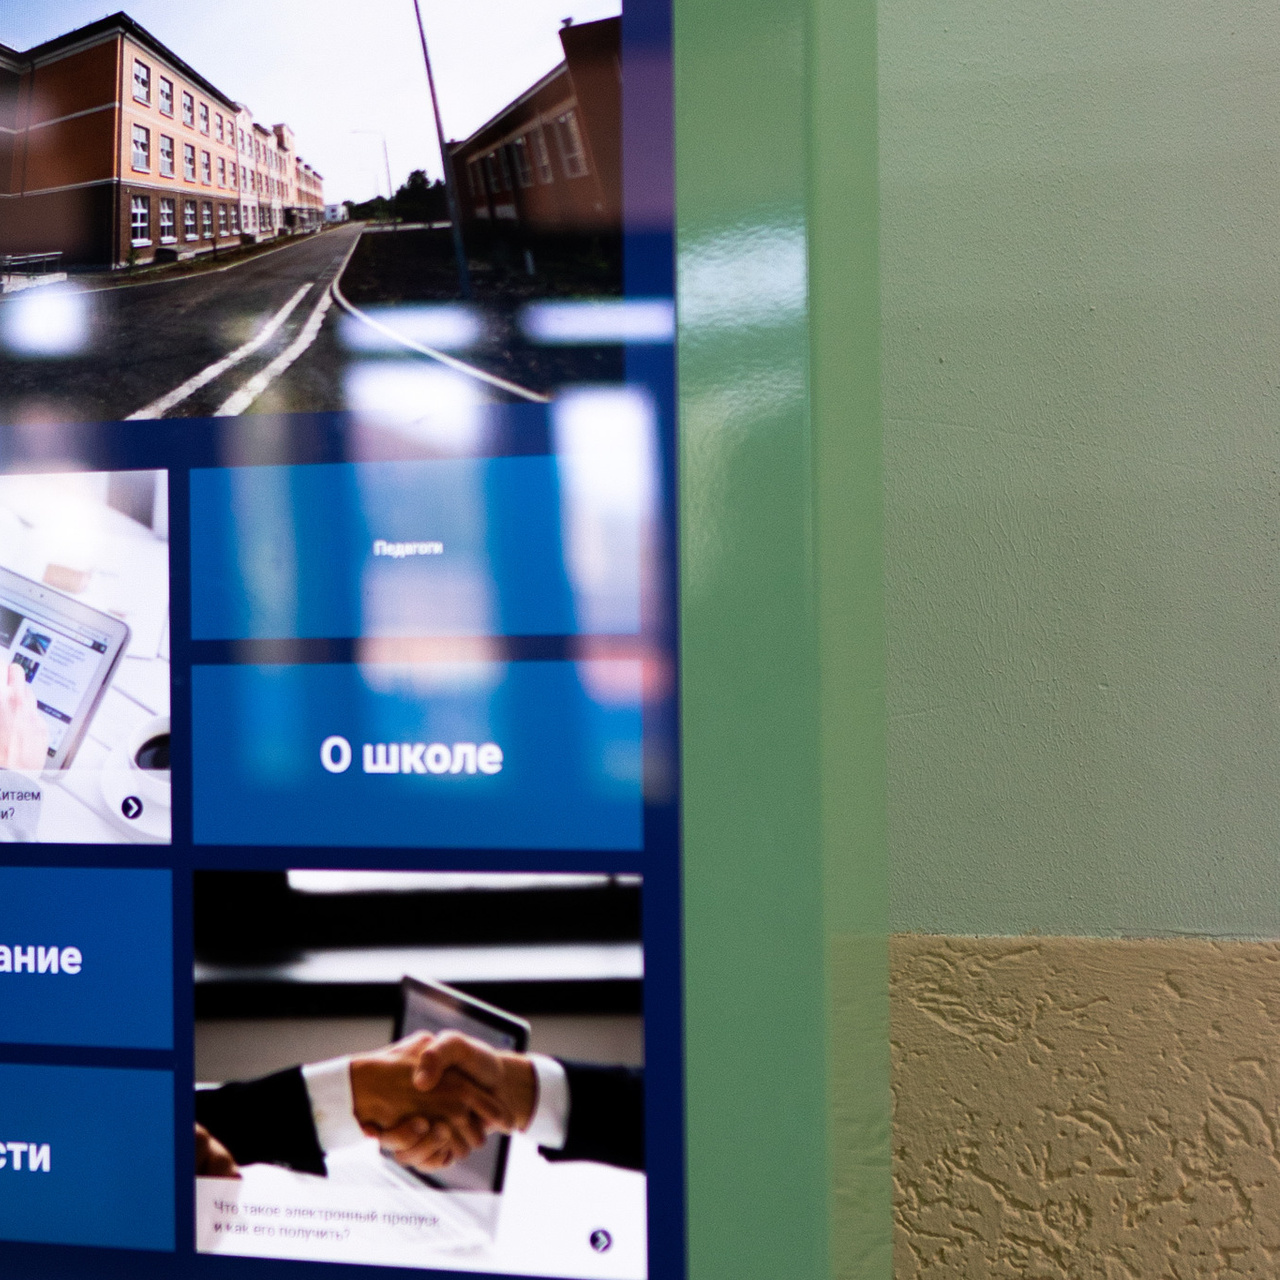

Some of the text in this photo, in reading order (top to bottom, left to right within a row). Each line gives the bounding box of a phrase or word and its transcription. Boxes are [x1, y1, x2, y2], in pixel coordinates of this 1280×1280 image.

[320, 735, 504, 775] О школе
[213, 1199, 239, 1215] Что
